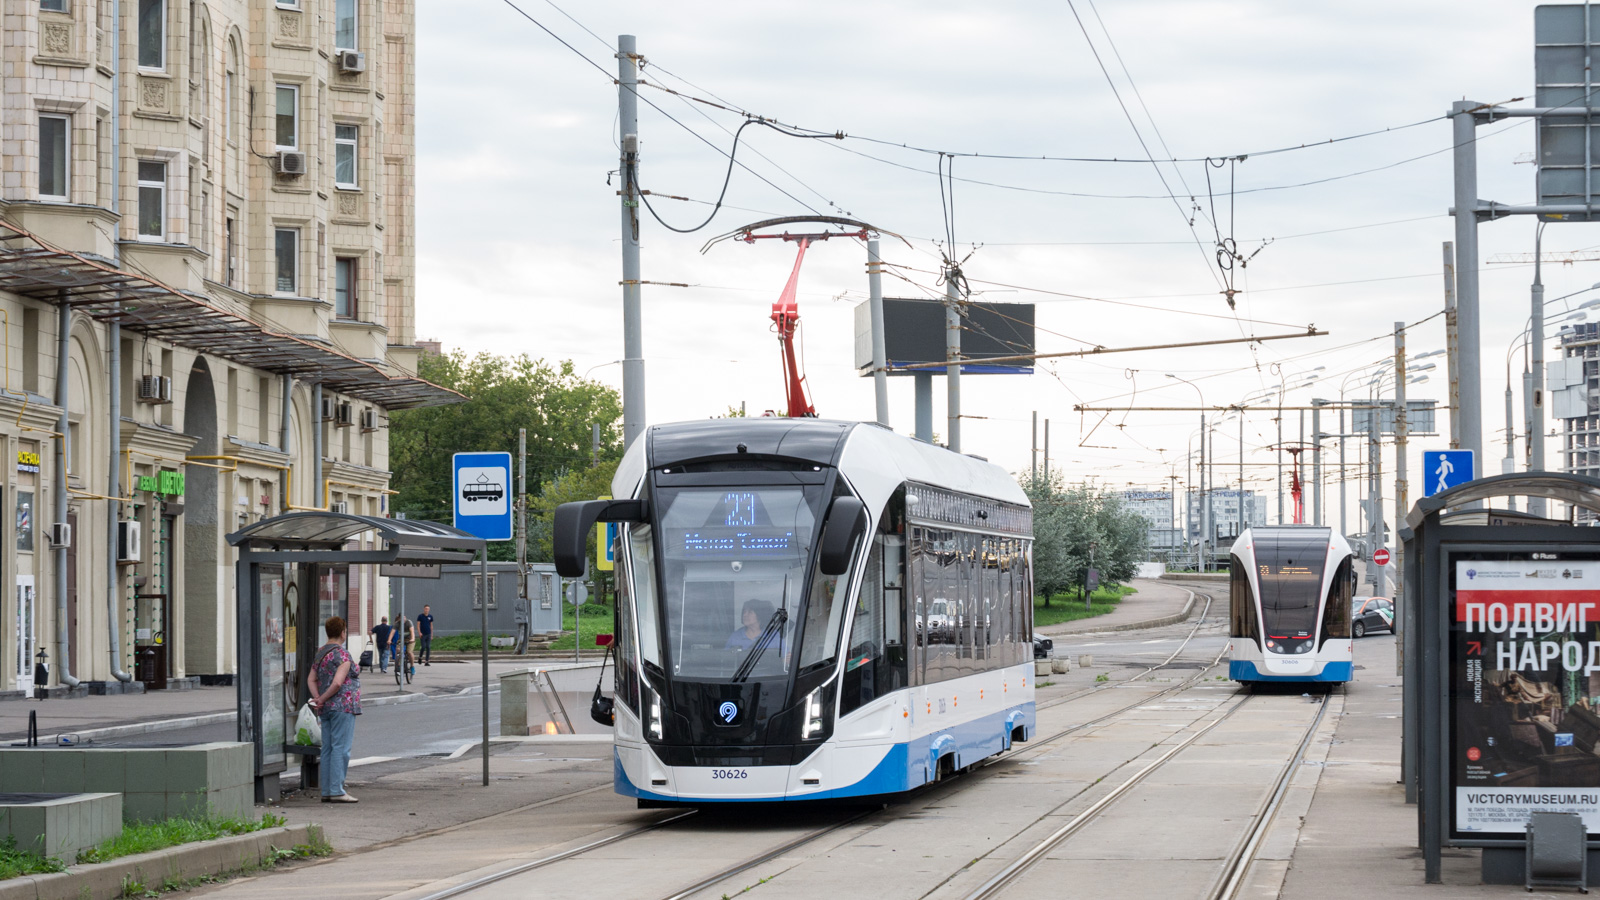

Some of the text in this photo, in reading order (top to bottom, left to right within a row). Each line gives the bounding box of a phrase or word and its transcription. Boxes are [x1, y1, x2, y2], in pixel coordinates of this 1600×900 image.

[158, 471, 184, 498] ЦВЕТОВ
[1539, 552, 1558, 560] Russ
[1465, 602, 1596, 638] ПОДВИГ
[1466, 659, 1474, 682] НОВАЯ
[1474, 659, 1483, 704] ЭКСПОЗИЦИЯ
[712, 769, 748, 779] 30626
[1467, 793, 1598, 805] VICTORYMUSEUM.RU
